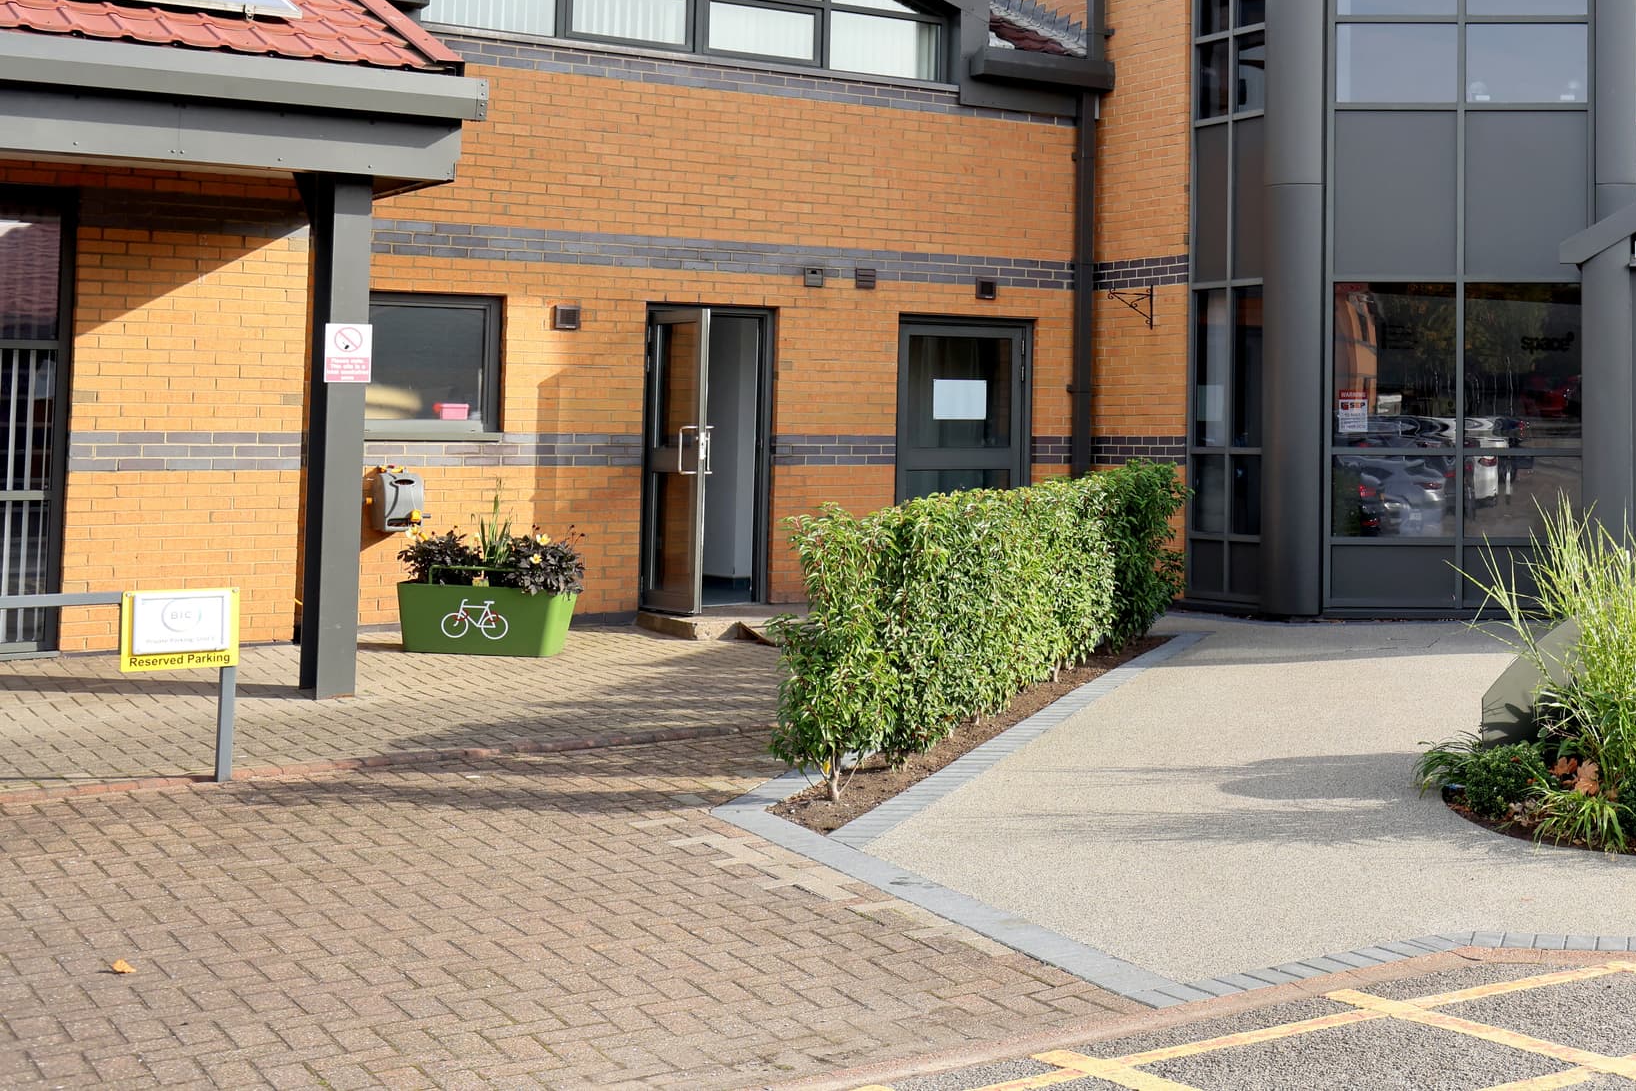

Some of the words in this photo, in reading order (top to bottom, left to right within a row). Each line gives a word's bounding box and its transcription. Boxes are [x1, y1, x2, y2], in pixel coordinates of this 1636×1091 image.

[170, 610, 193, 620] BIC
[129, 655, 184, 667] Reserved
[187, 653, 231, 664] Parking
